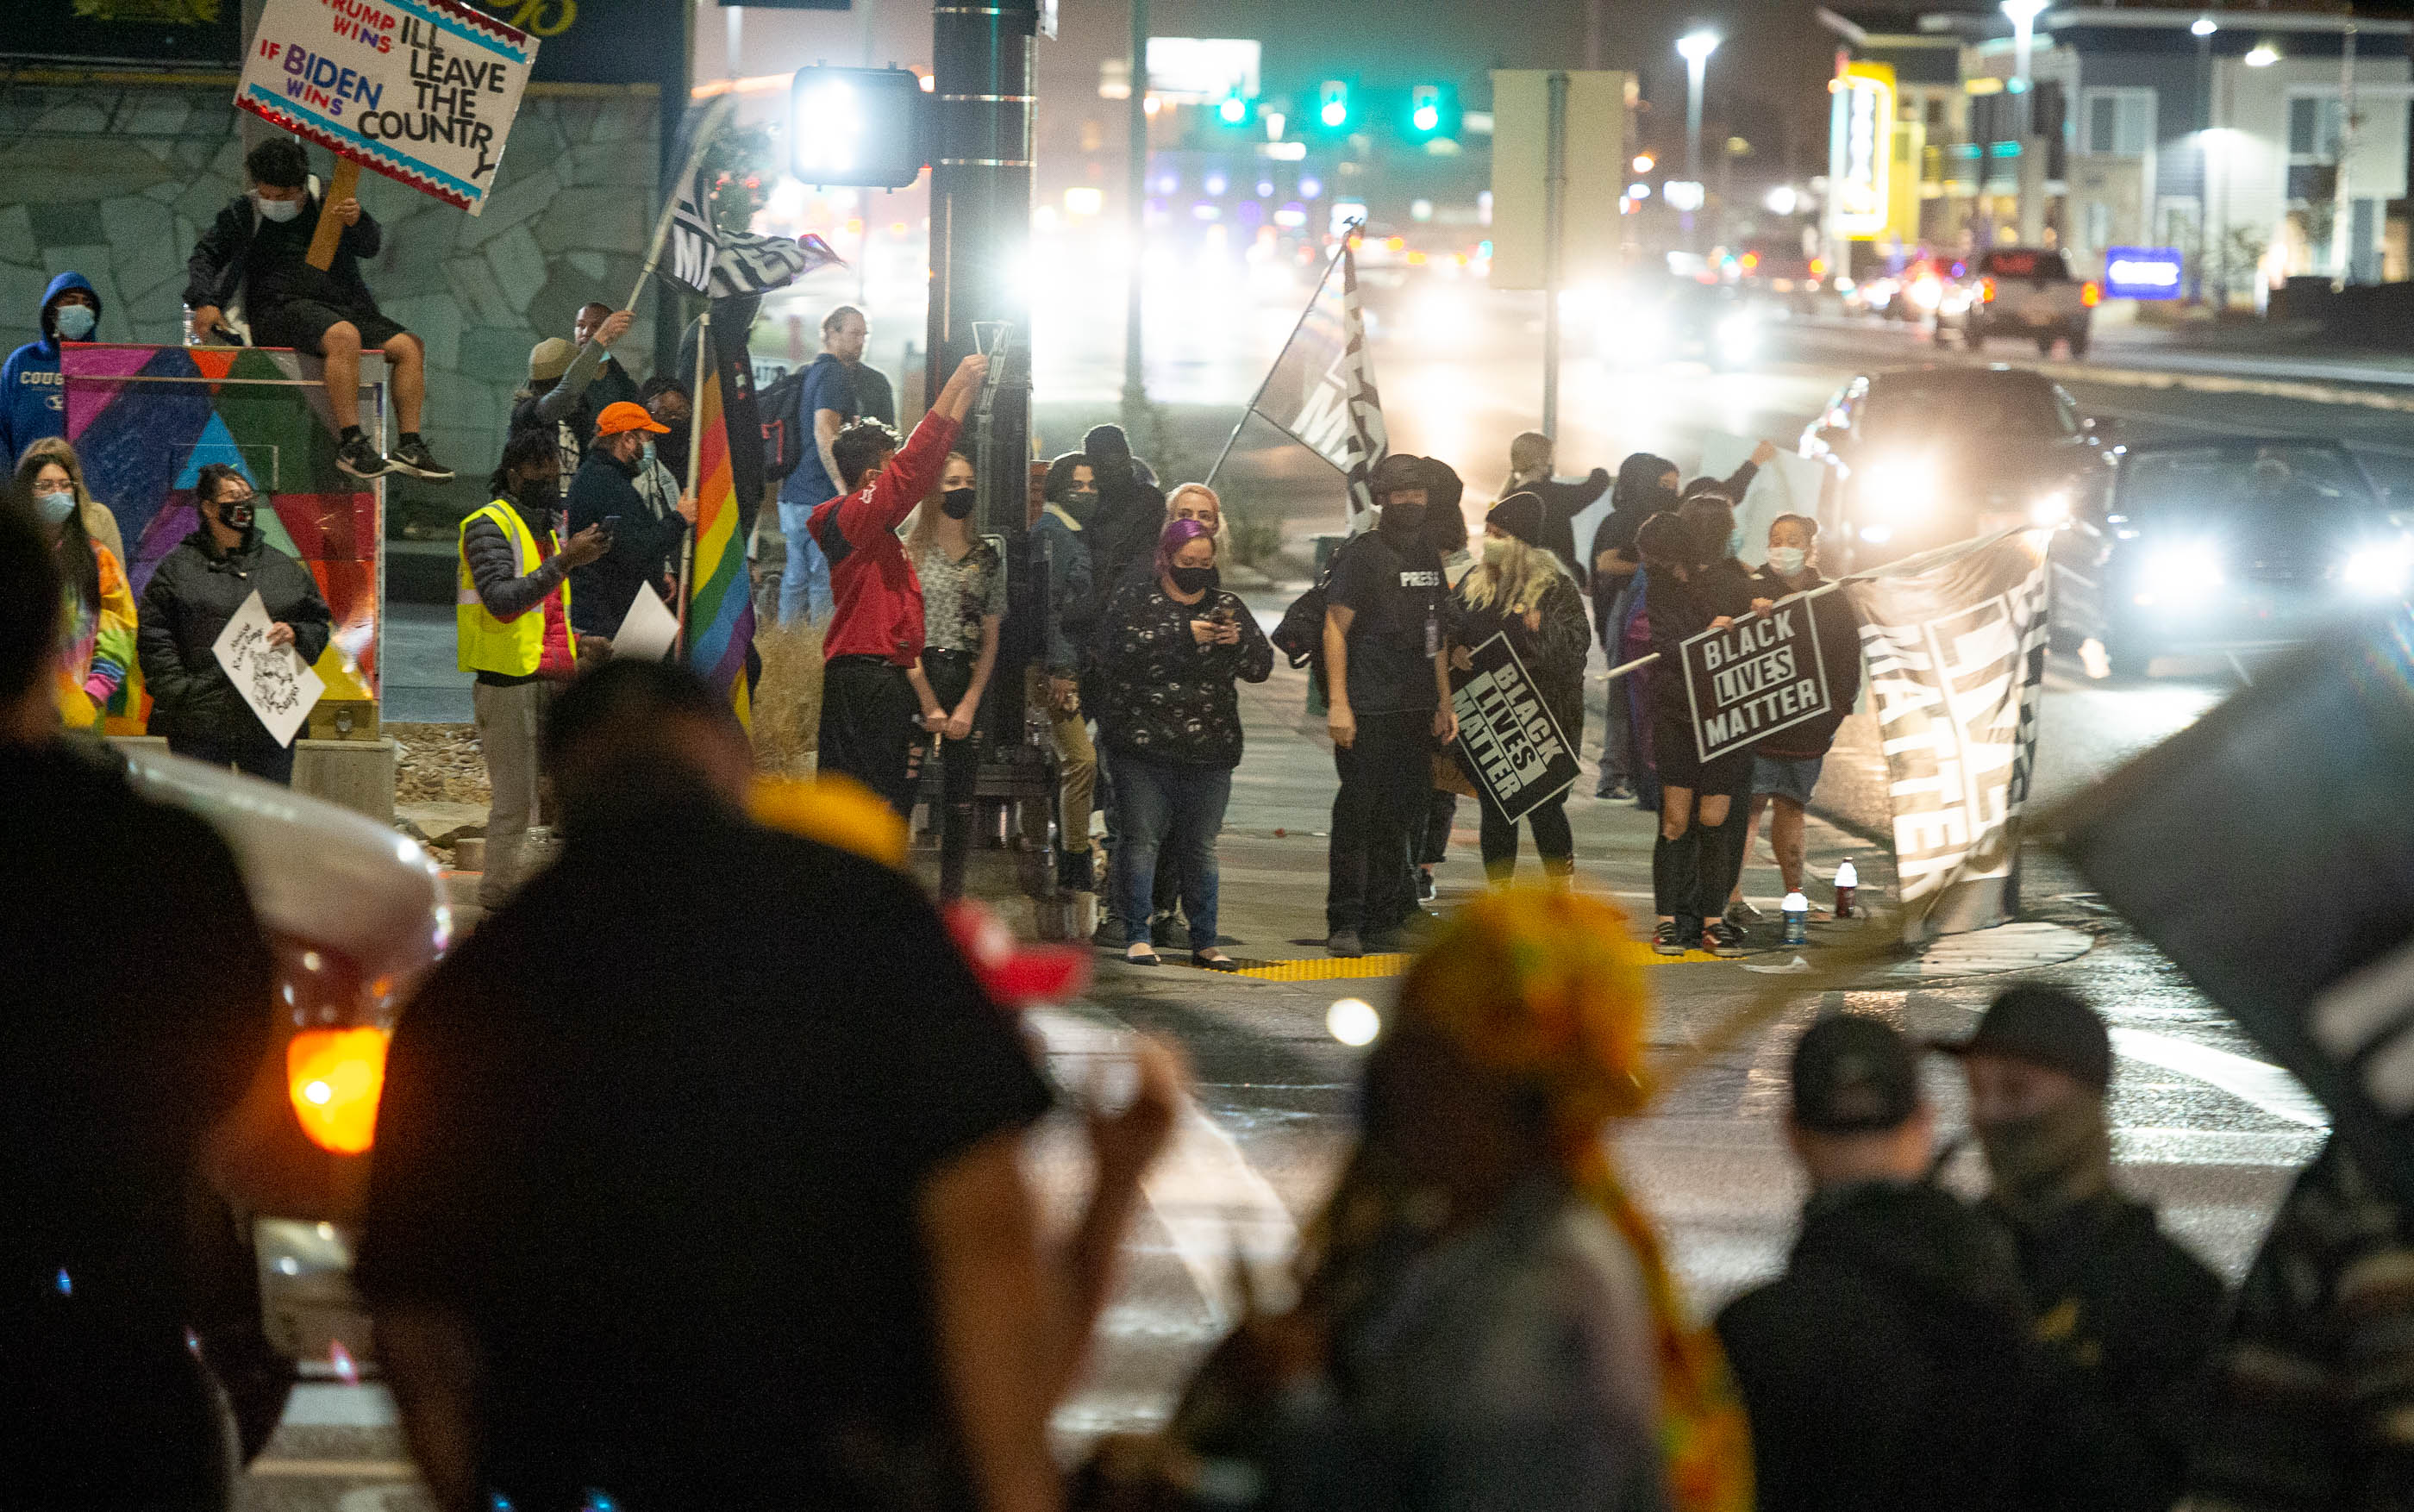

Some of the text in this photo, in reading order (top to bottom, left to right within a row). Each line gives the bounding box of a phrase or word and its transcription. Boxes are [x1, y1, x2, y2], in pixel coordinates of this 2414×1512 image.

[322, 0, 396, 31] RUMP
[333, 15, 392, 53] WINS
[401, 16, 444, 53] ILL
[260, 39, 383, 110] IF BIDEN
[410, 49, 506, 93] LEAVE
[287, 78, 343, 116] WINS
[412, 80, 477, 119] THE
[1400, 572, 1440, 586] PRESS
[1703, 609, 1796, 671] BLACK
[1718, 650, 1792, 703] LIVES
[1475, 684, 1536, 771] LIVES
[1492, 662, 1565, 765] BLACK
[1704, 678, 1819, 747] MATTER
[1451, 688, 1522, 801] MATTER
